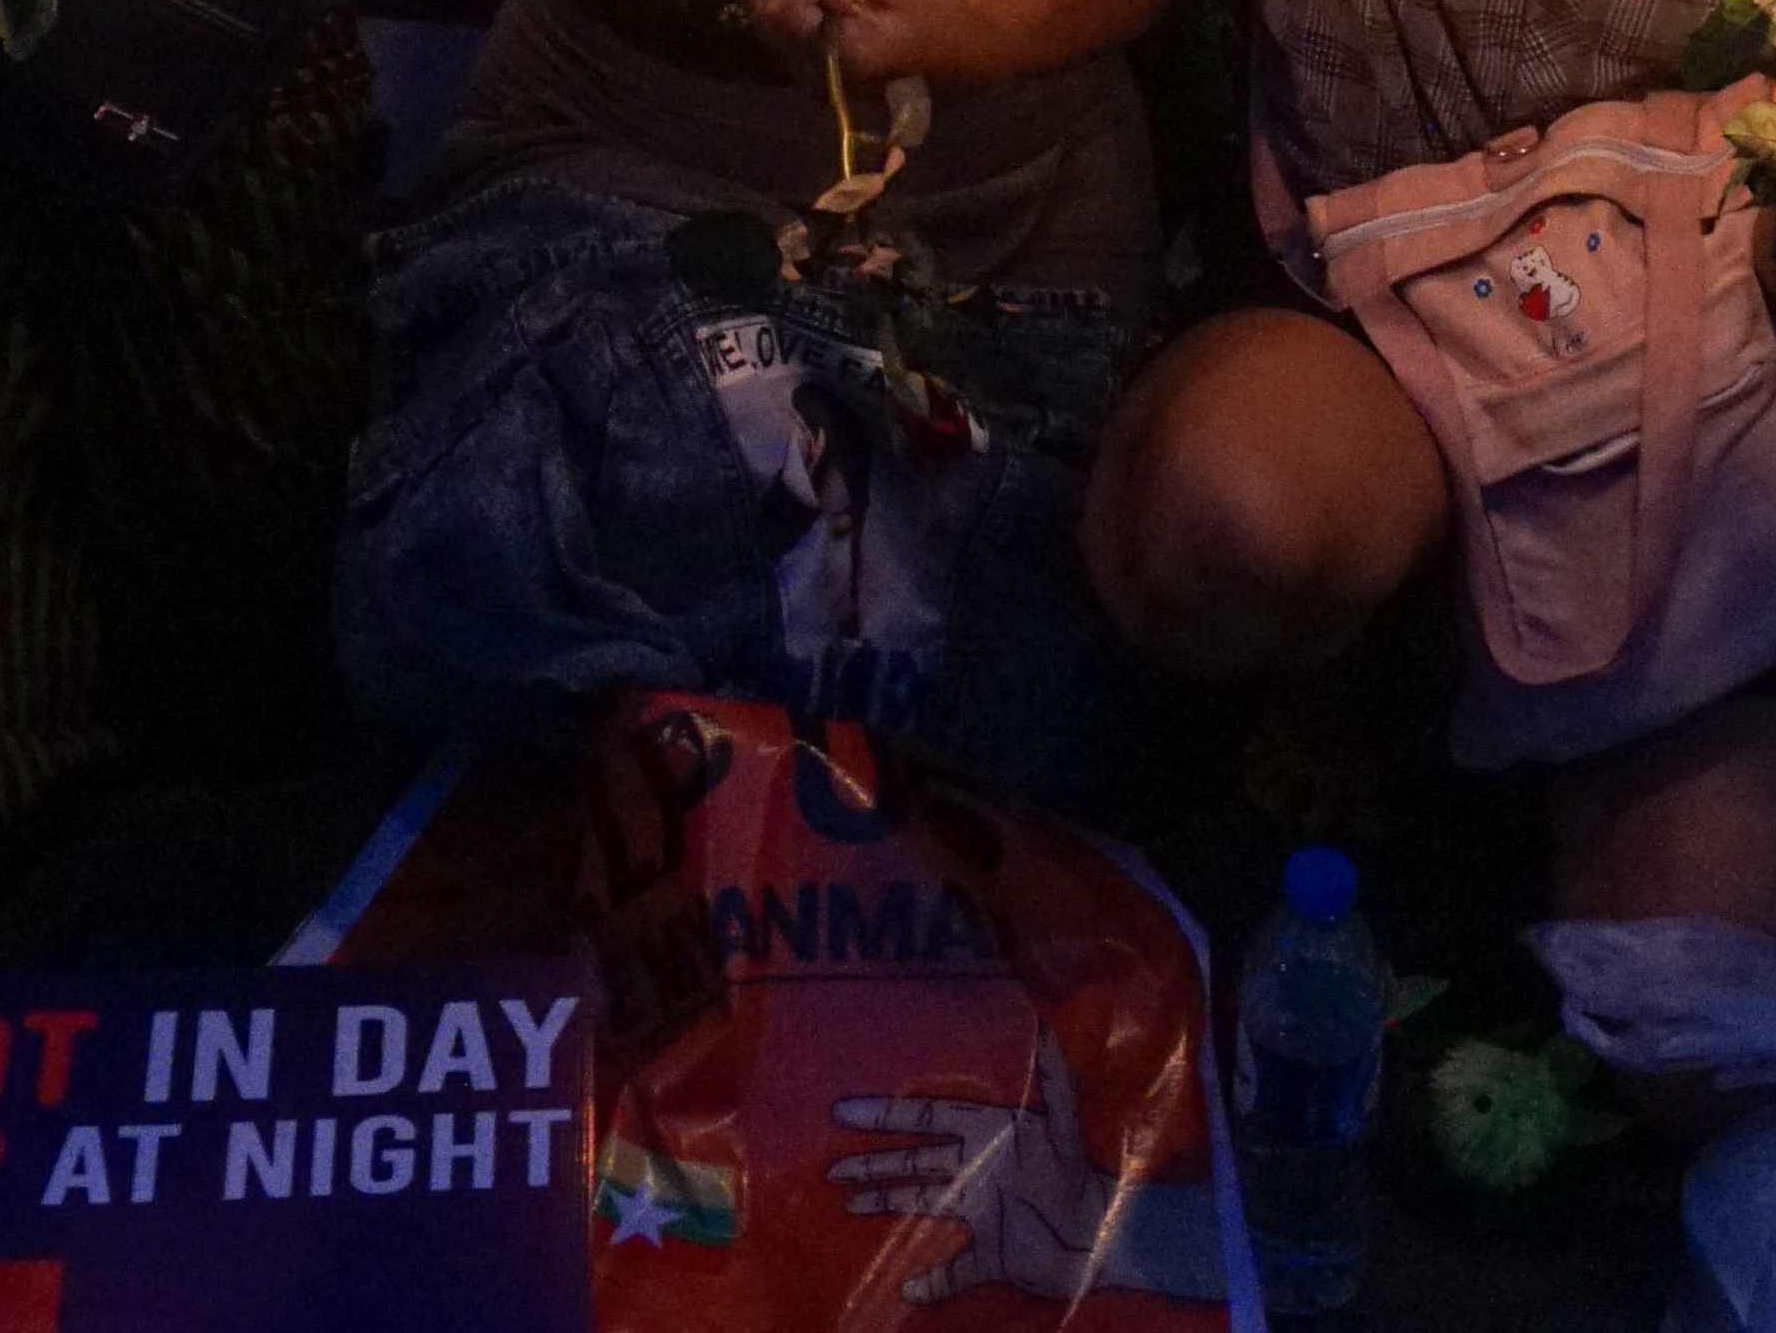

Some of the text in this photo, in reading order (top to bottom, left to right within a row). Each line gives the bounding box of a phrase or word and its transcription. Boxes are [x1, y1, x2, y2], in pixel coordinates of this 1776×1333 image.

[143, 1007, 276, 1104] IN
[330, 995, 580, 1098] DAY
[40, 1121, 184, 1206] AT
[222, 1107, 573, 1202] NIGHT
